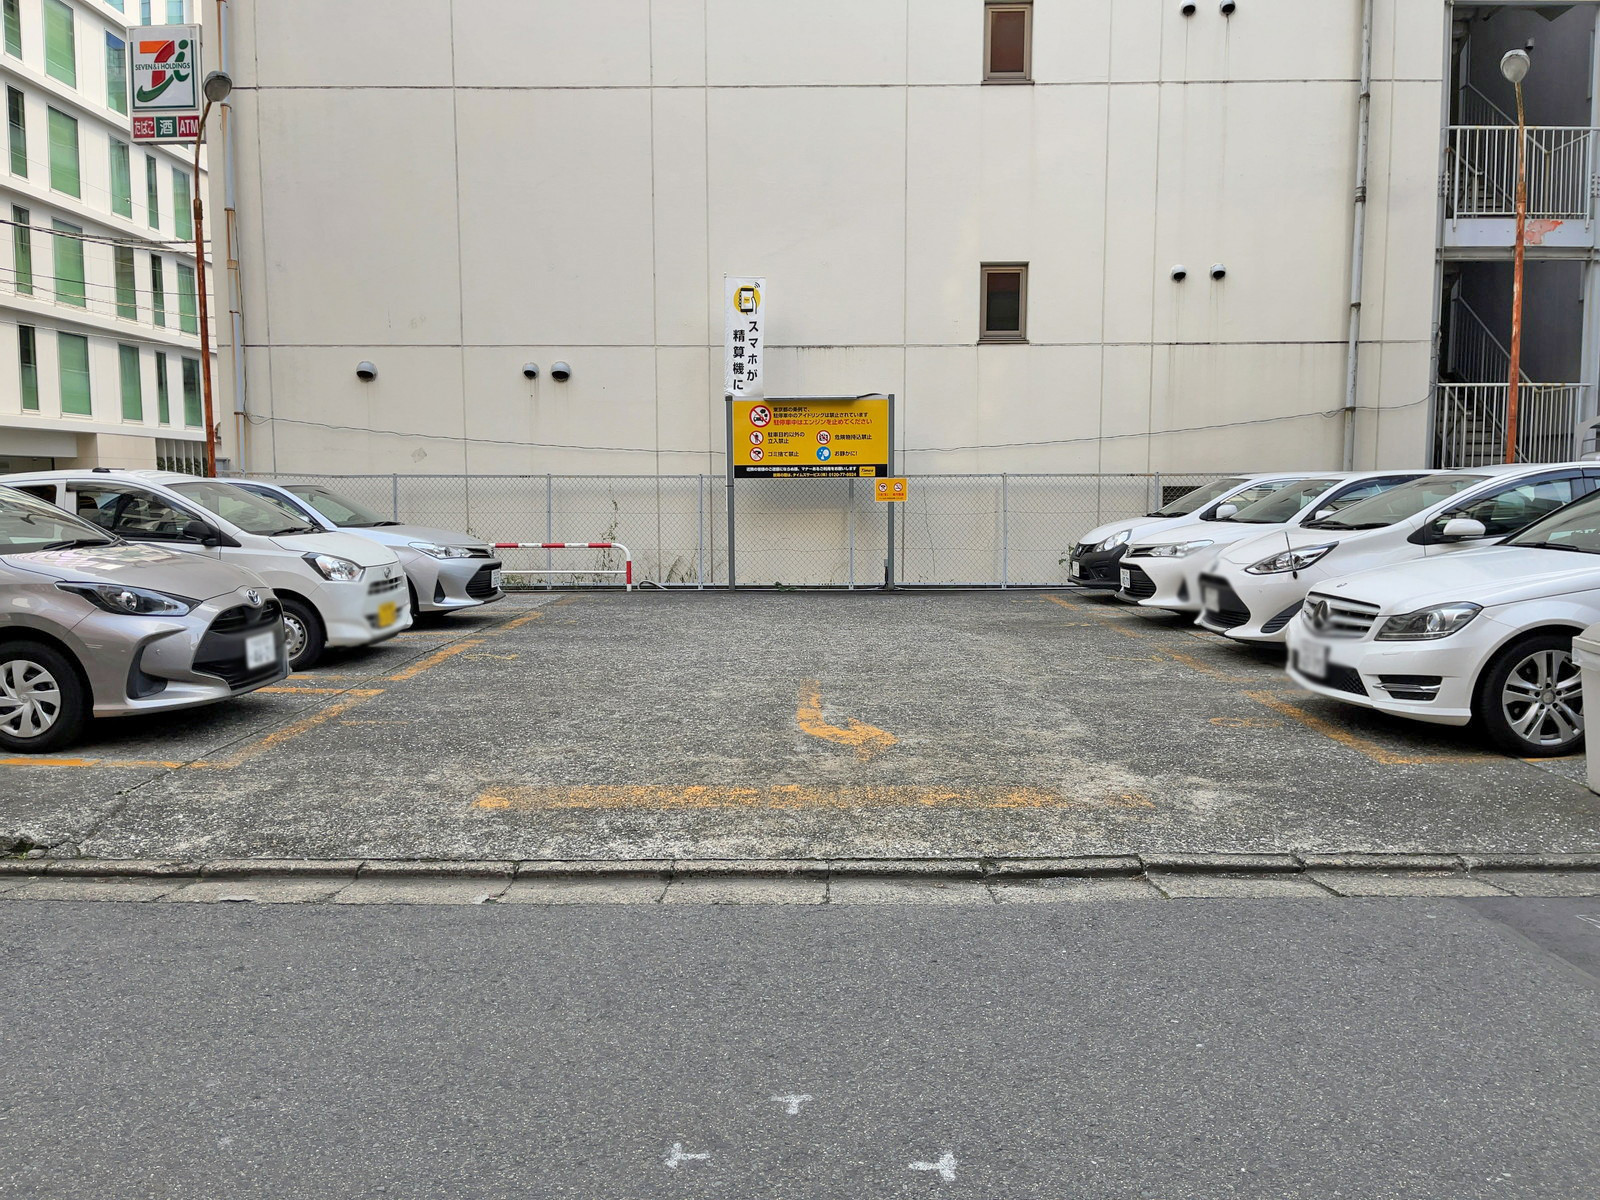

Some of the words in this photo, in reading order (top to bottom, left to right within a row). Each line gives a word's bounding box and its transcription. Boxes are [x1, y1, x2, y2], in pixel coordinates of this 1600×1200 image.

[160, 62, 191, 70] HOLDINGS
[134, 120, 154, 135] たばこ
[159, 119, 174, 136] 酒
[179, 119, 199, 134] ATM
[746, 320, 759, 382] スマホが
[732, 329, 745, 391] 精算機に
